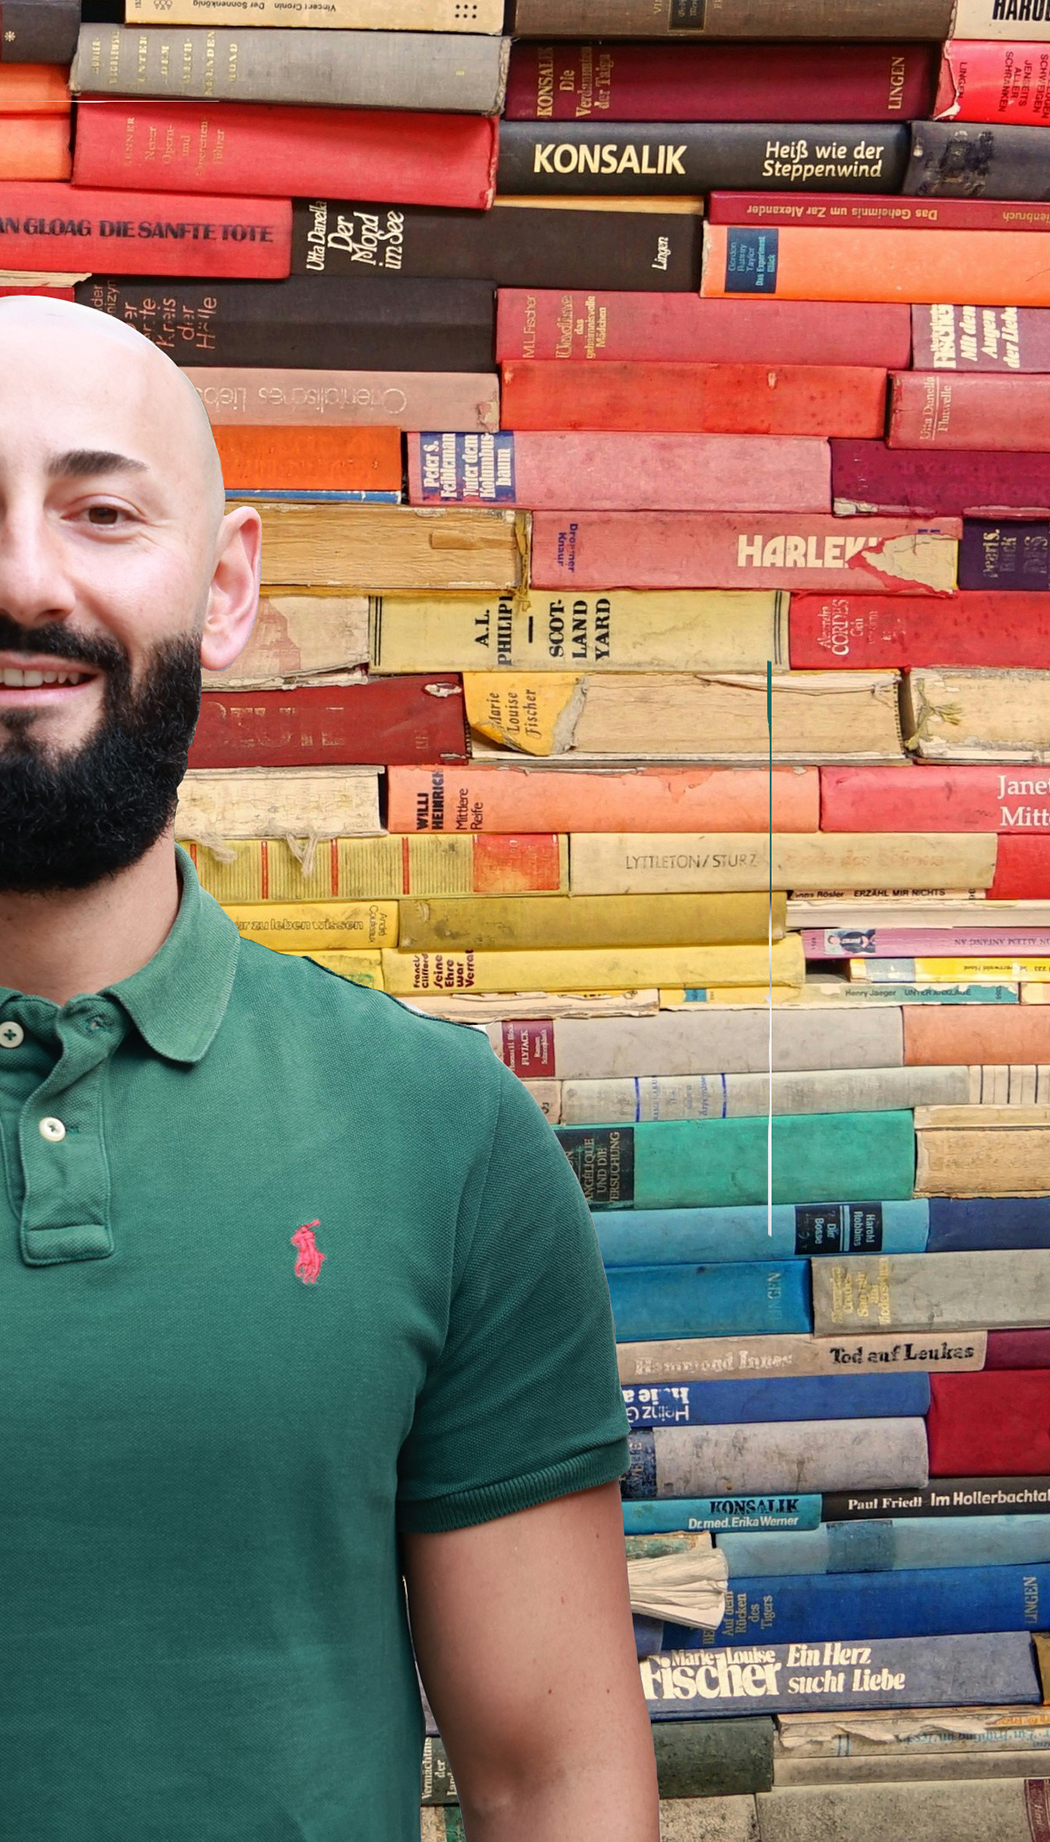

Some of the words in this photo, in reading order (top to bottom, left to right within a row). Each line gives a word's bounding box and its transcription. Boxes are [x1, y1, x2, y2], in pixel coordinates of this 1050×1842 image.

[274, 2, 301, 10] Cronin
[559, 69, 575, 92] Die
[594, 53, 615, 82] Taiga
[888, 56, 906, 111] LINGEN
[998, 51, 1015, 113] SCHRANKEN
[1010, 67, 1023, 99] ALLER
[594, 84, 610, 111] der
[533, 143, 688, 175] KONSALIK
[765, 140, 809, 162] Heiß
[815, 142, 847, 160] wie
[853, 141, 884, 160] der
[762, 160, 883, 182] Steppenwind
[747, 205, 803, 217] Alexander
[806, 206, 826, 217] Zar
[830, 206, 847, 216] um
[851, 206, 911, 220] Geheimnis
[915, 209, 938, 221] Das
[23, 217, 92, 237] GLOAG
[99, 219, 135, 239] DIE
[137, 221, 217, 242] SANFTE
[219, 224, 275, 244] TOTE
[327, 214, 355, 253] Der
[350, 211, 380, 266] Mond
[377, 209, 405, 242] See
[306, 244, 324, 272] Utta
[382, 243, 403, 270] im
[651, 236, 669, 271] Lingen
[573, 319, 585, 335] das
[981, 309, 1001, 360] Augen
[1002, 342, 1021, 369] der
[549, 599, 566, 658] SCOT-
[571, 600, 589, 660] LAND
[595, 598, 611, 661] YARD
[504, 691, 521, 733] Louise
[521, 689, 543, 739] Fischer
[416, 792, 430, 831] WILLI
[455, 788, 469, 831] Mittlere
[470, 801, 484, 831] Reife
[854, 887, 889, 897] ERZÄHL
[444, 958, 455, 989] Ehre
[596, 1165, 607, 1194] UND
[830, 1346, 863, 1365] Tod
[867, 1344, 901, 1363] auf
[904, 1343, 976, 1362] Leukas
[710, 1498, 800, 1516] KONSALIK
[848, 1497, 878, 1511] Paul
[881, 1495, 923, 1510] Friedl
[930, 1492, 950, 1507] Im
[734, 1592, 747, 1635] Rücken
[749, 1603, 760, 1623] des
[760, 1594, 773, 1631] Tigers
[1023, 1575, 1039, 1626] LINGEN
[721, 1616, 734, 1637] Auf
[670, 1649, 716, 1666] Marie
[726, 1646, 776, 1664] Louise
[786, 1644, 820, 1668] Ein
[823, 1642, 872, 1665] Herz
[640, 1653, 782, 1700] Fischer
[787, 1669, 846, 1695] sucht
[852, 1668, 906, 1693] Liebe
[434, 1759, 446, 1778] der
